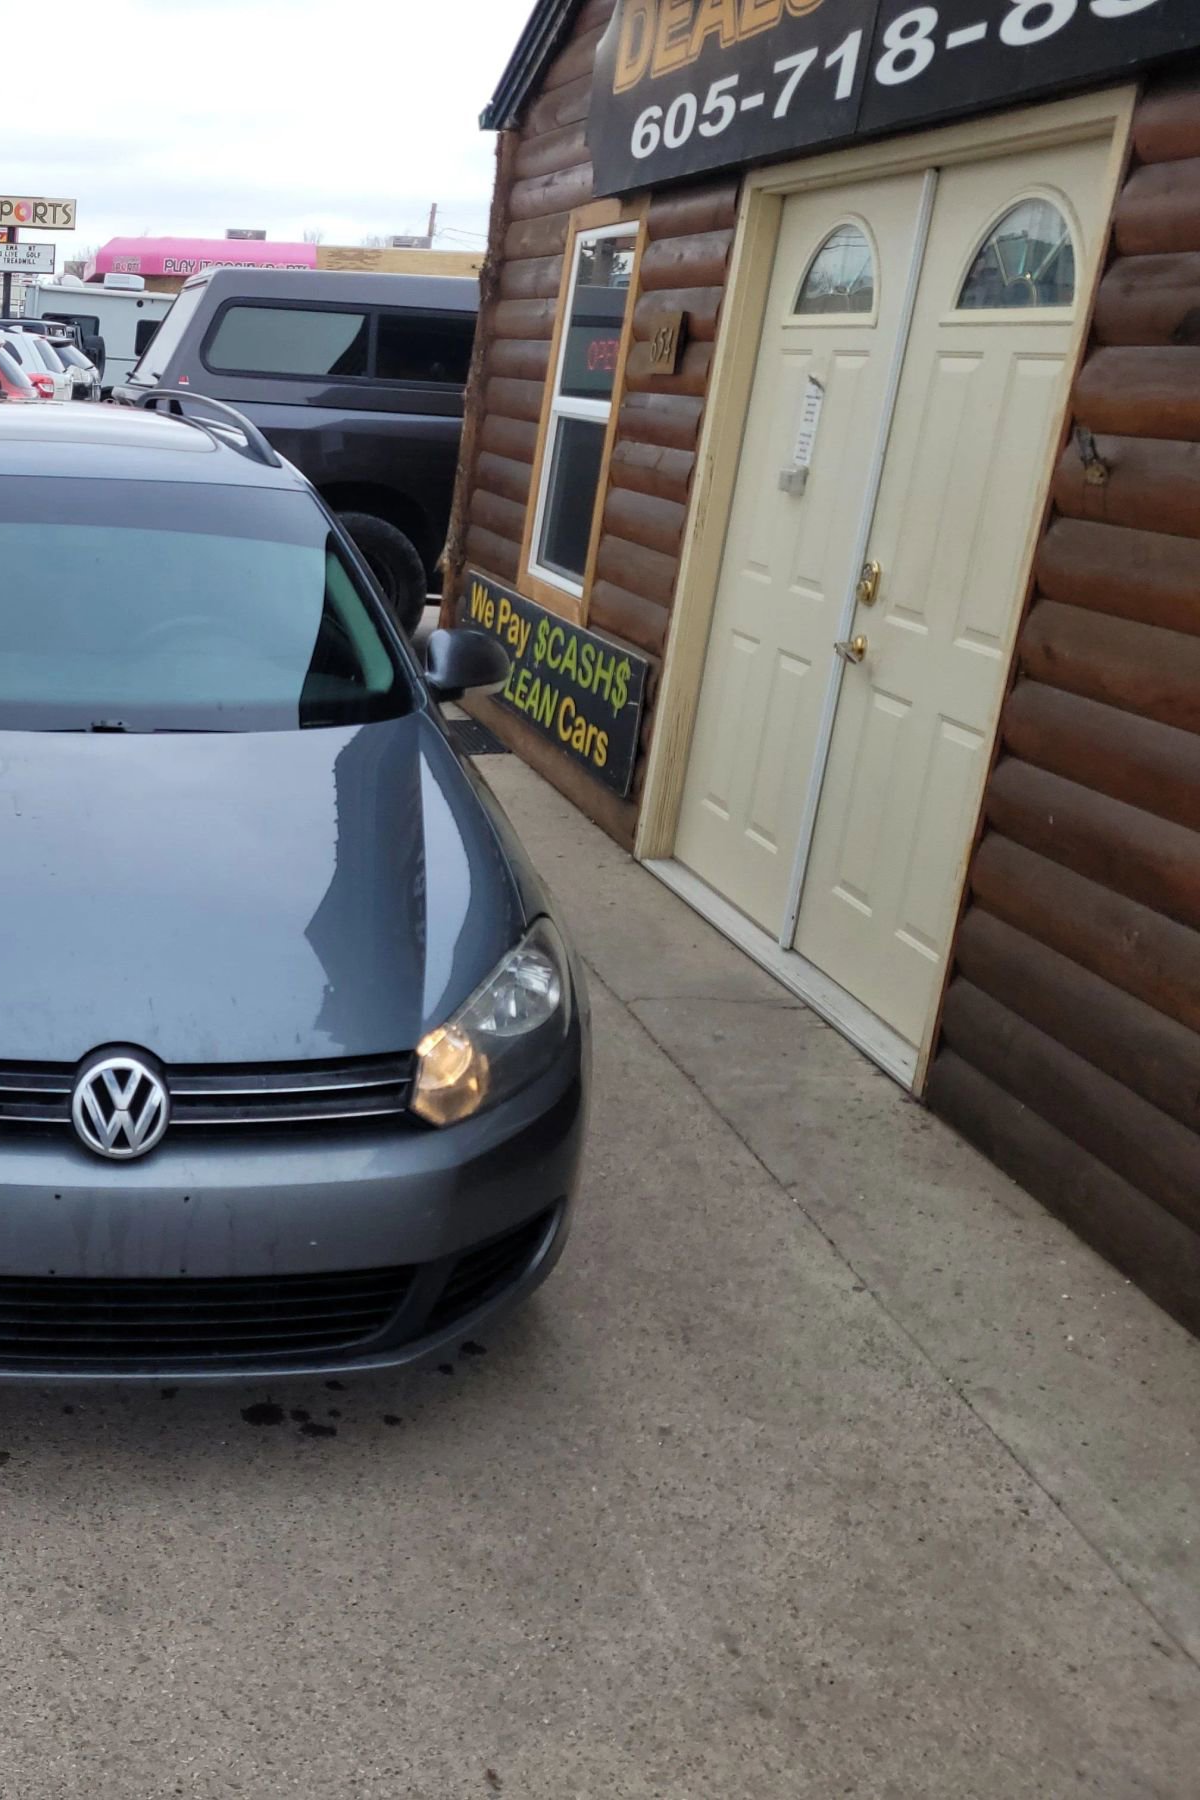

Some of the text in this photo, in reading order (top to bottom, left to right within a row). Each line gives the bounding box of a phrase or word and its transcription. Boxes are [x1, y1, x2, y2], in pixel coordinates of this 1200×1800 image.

[613, 0, 825, 95] DEAL
[164, 258, 195, 273] PLAY
[650, 328, 674, 364] 654
[470, 581, 631, 719] We Pay $CASH$
[502, 661, 608, 767] LEAN Cars
